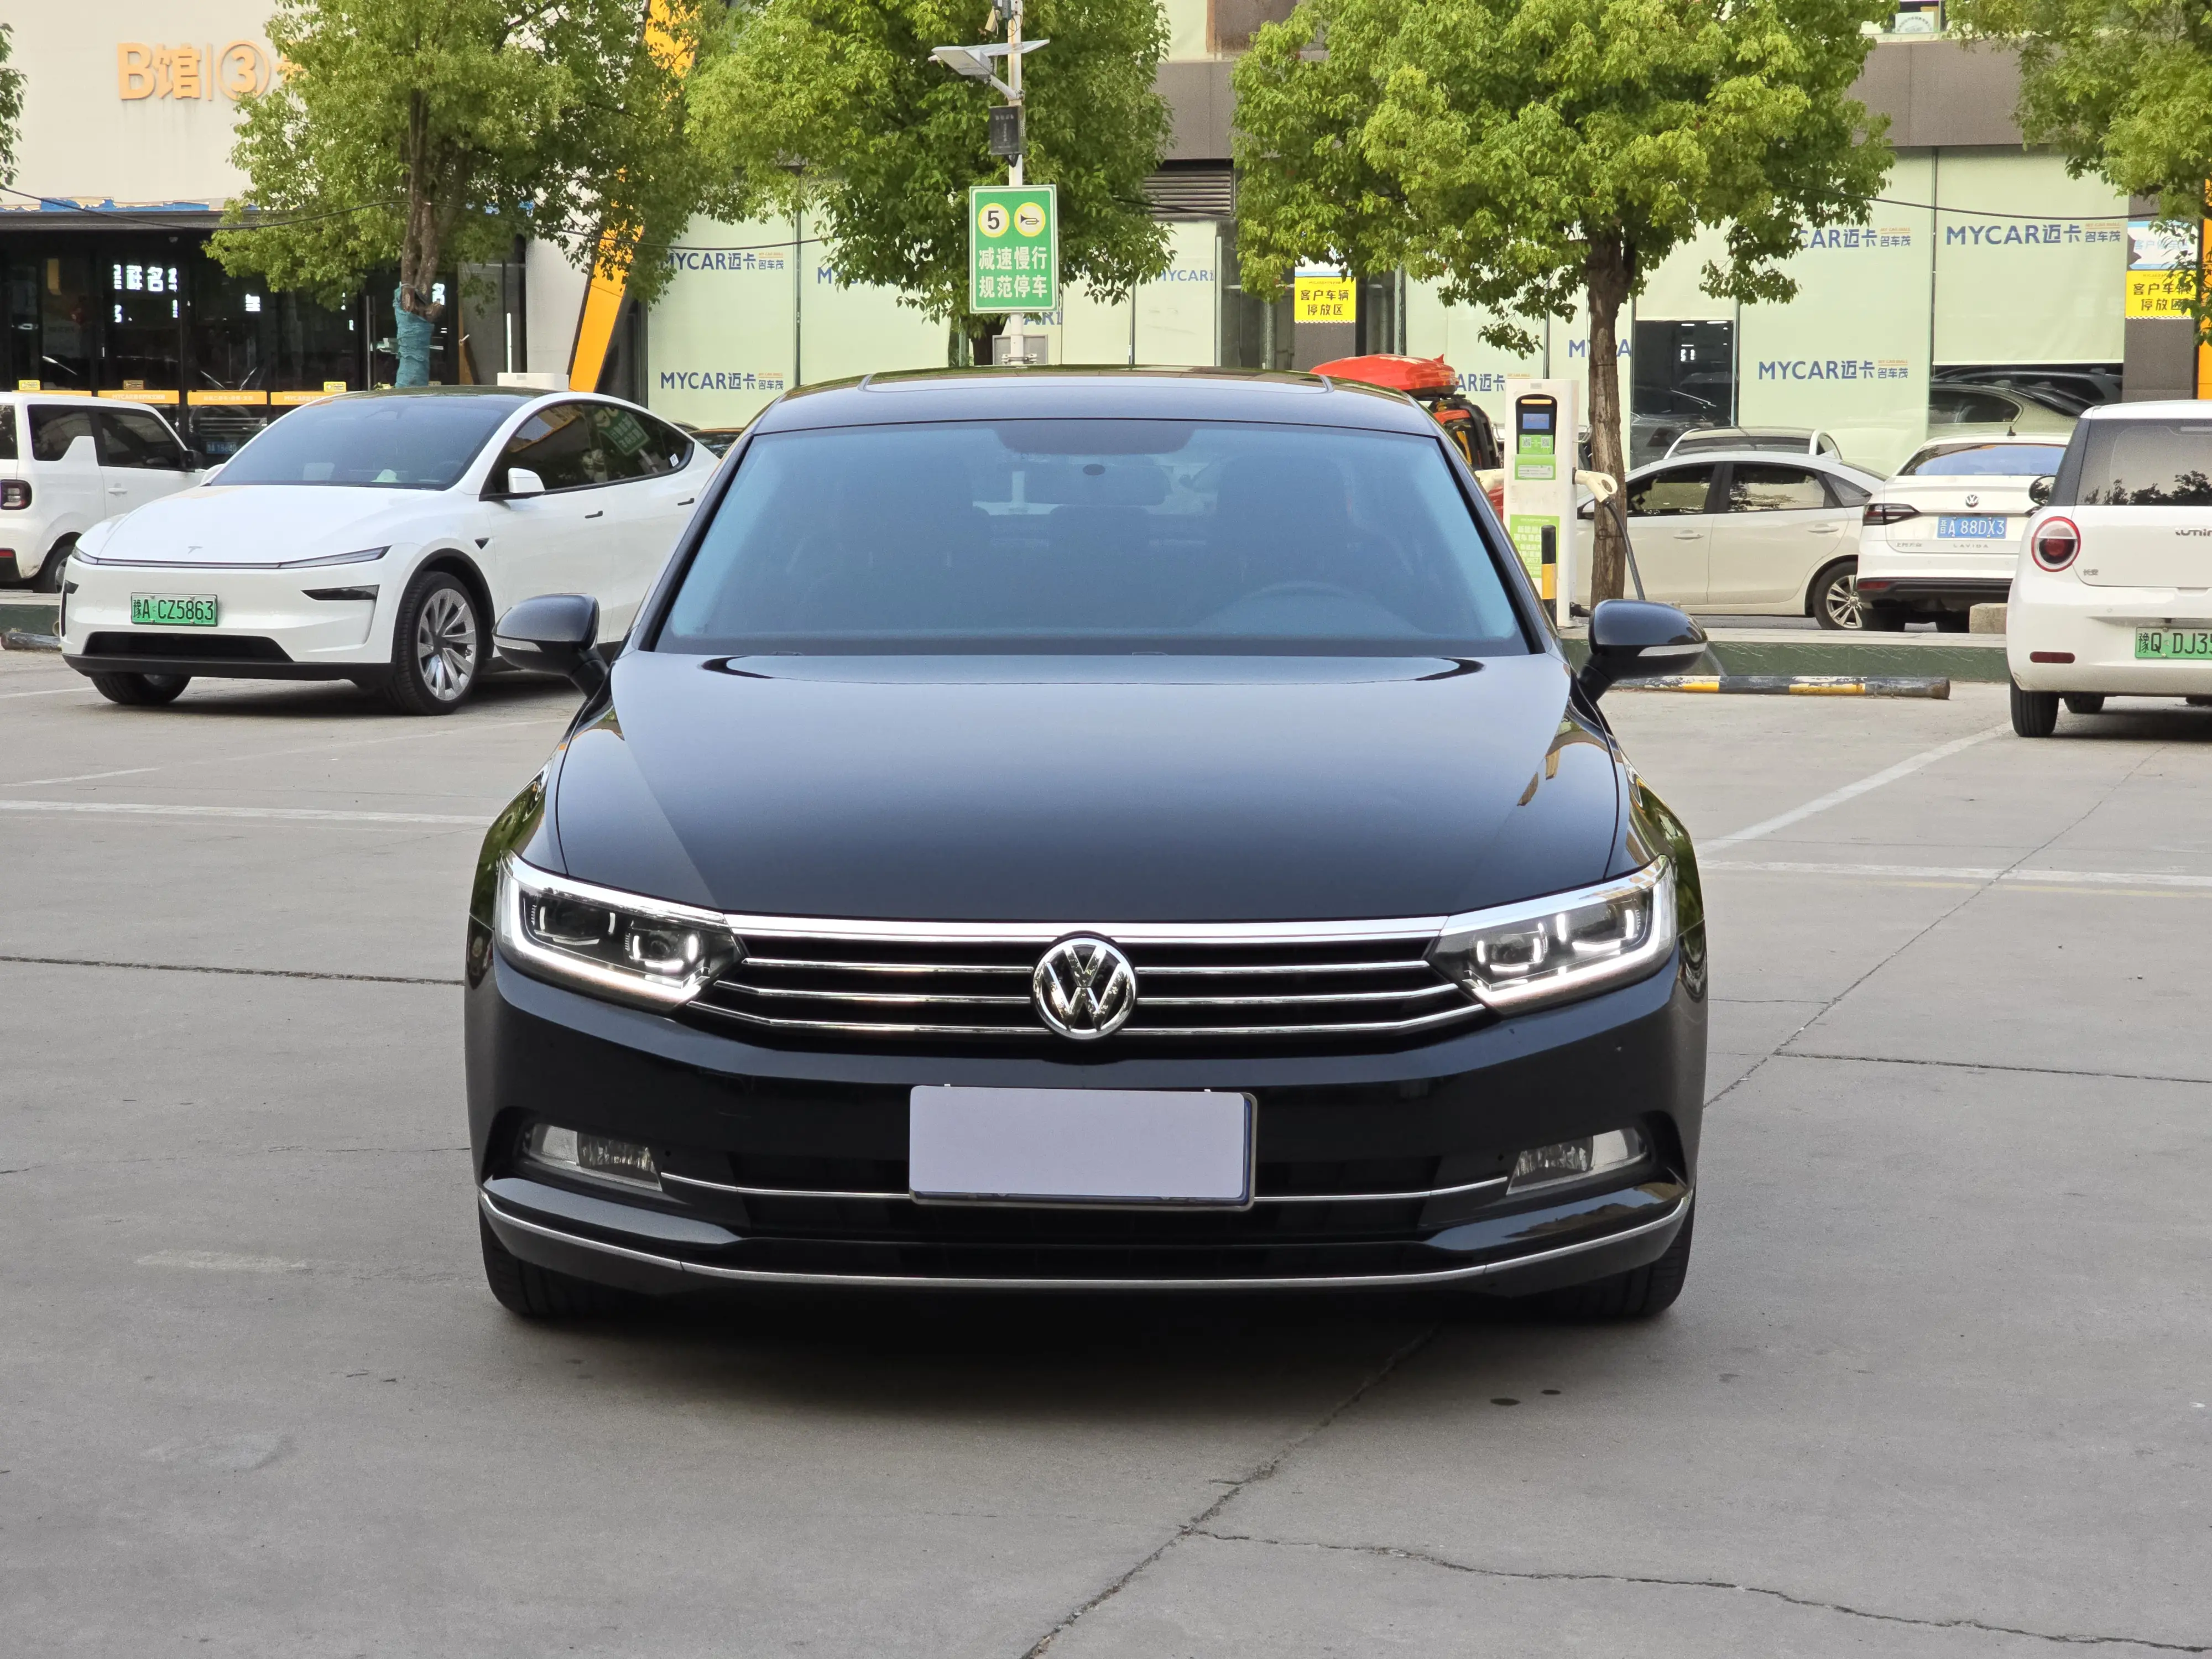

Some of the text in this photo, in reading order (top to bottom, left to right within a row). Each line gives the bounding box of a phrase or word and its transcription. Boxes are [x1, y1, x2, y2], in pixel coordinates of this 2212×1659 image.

[988, 210, 1000, 229] 5
[979, 246, 1047, 270] 减速慢行
[979, 275, 1047, 298] 规范停车
[1300, 289, 1349, 301] 客户车辆
[1307, 304, 1343, 315] 停放区
